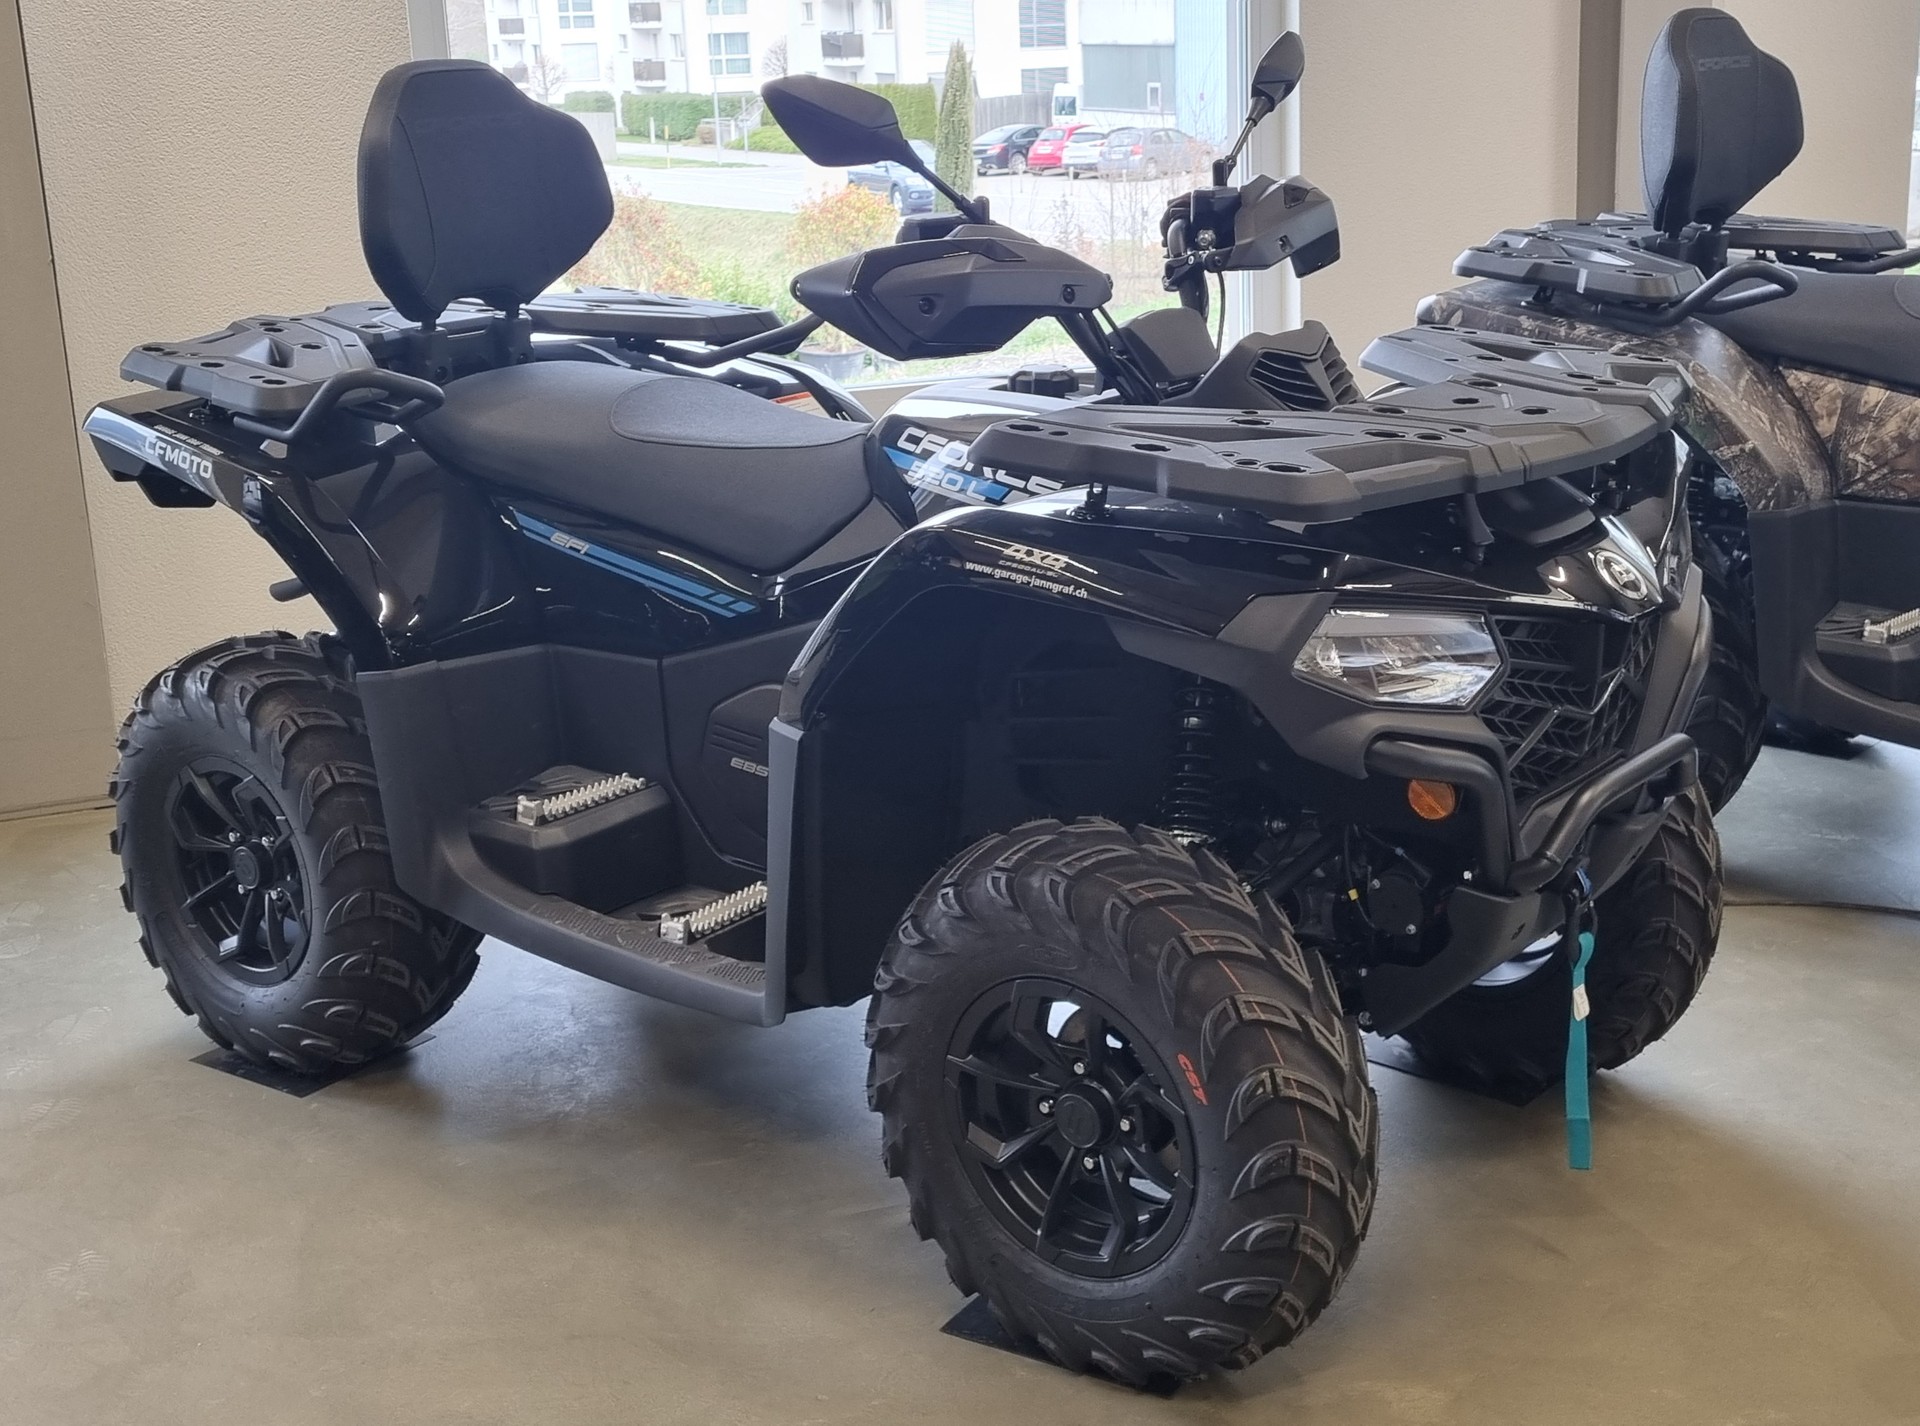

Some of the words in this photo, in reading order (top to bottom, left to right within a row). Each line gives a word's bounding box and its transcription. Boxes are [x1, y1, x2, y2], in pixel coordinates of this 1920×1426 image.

[144, 435, 213, 477] CFMOTO
[551, 532, 589, 554] EFI
[965, 561, 1088, 598] www.garage-janngraf.ch
[730, 757, 769, 777] EBS
[1177, 1053, 1208, 1105] CST
